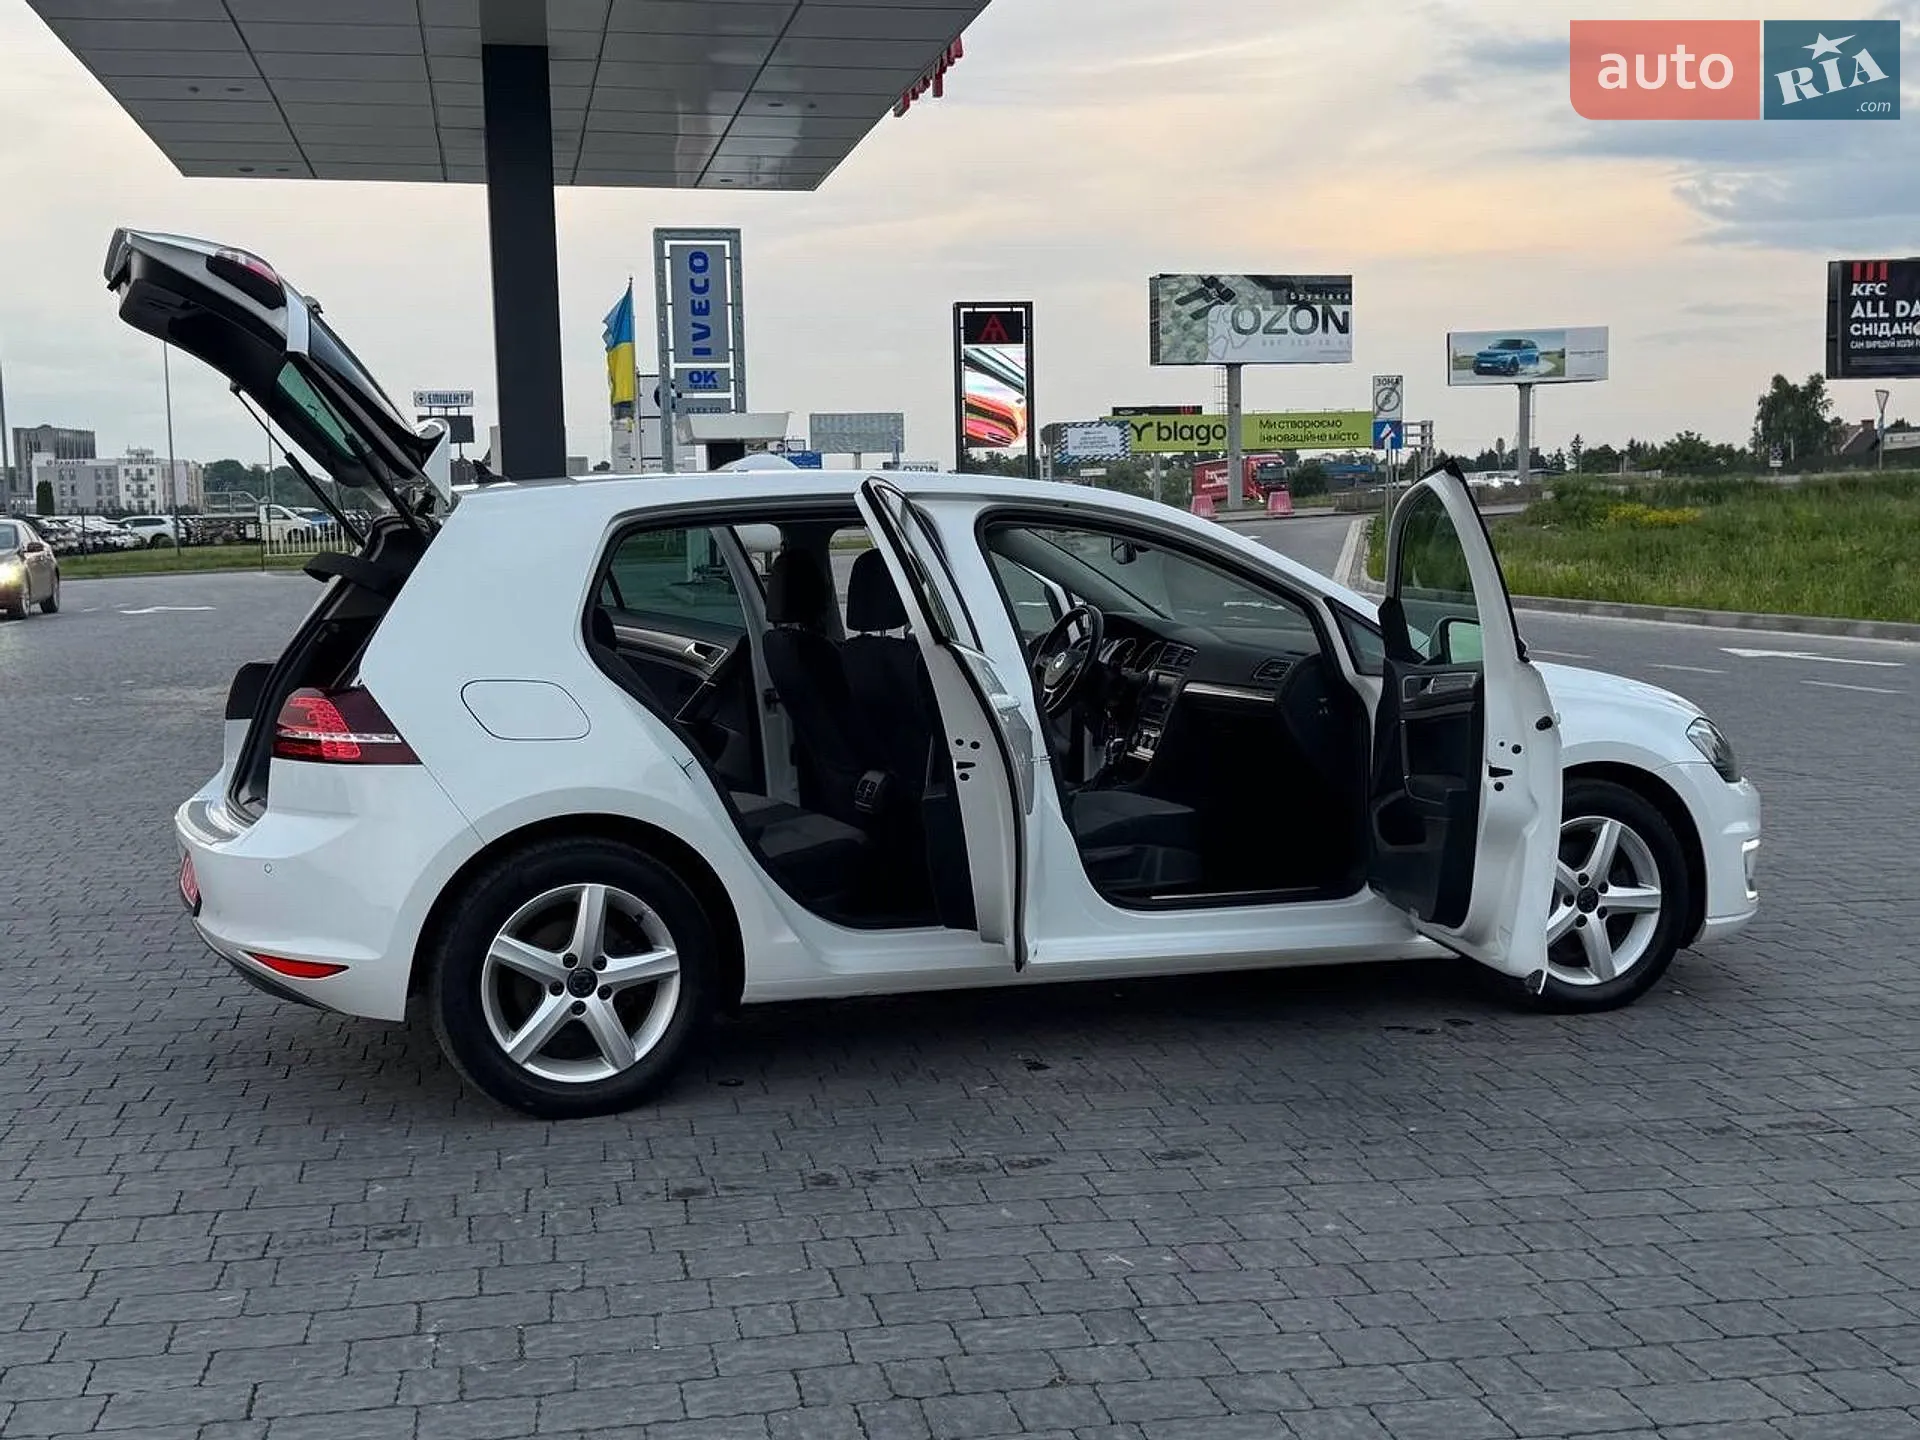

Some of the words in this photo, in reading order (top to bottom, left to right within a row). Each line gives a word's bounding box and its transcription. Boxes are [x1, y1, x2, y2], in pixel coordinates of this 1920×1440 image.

[1850, 283, 1888, 296] KFC
[688, 250, 712, 356] IVECO
[1850, 300, 1889, 318] ALL
[1231, 304, 1349, 336] OZON
[1850, 322, 1920, 338] СНІДАН
[689, 371, 718, 384] OK
